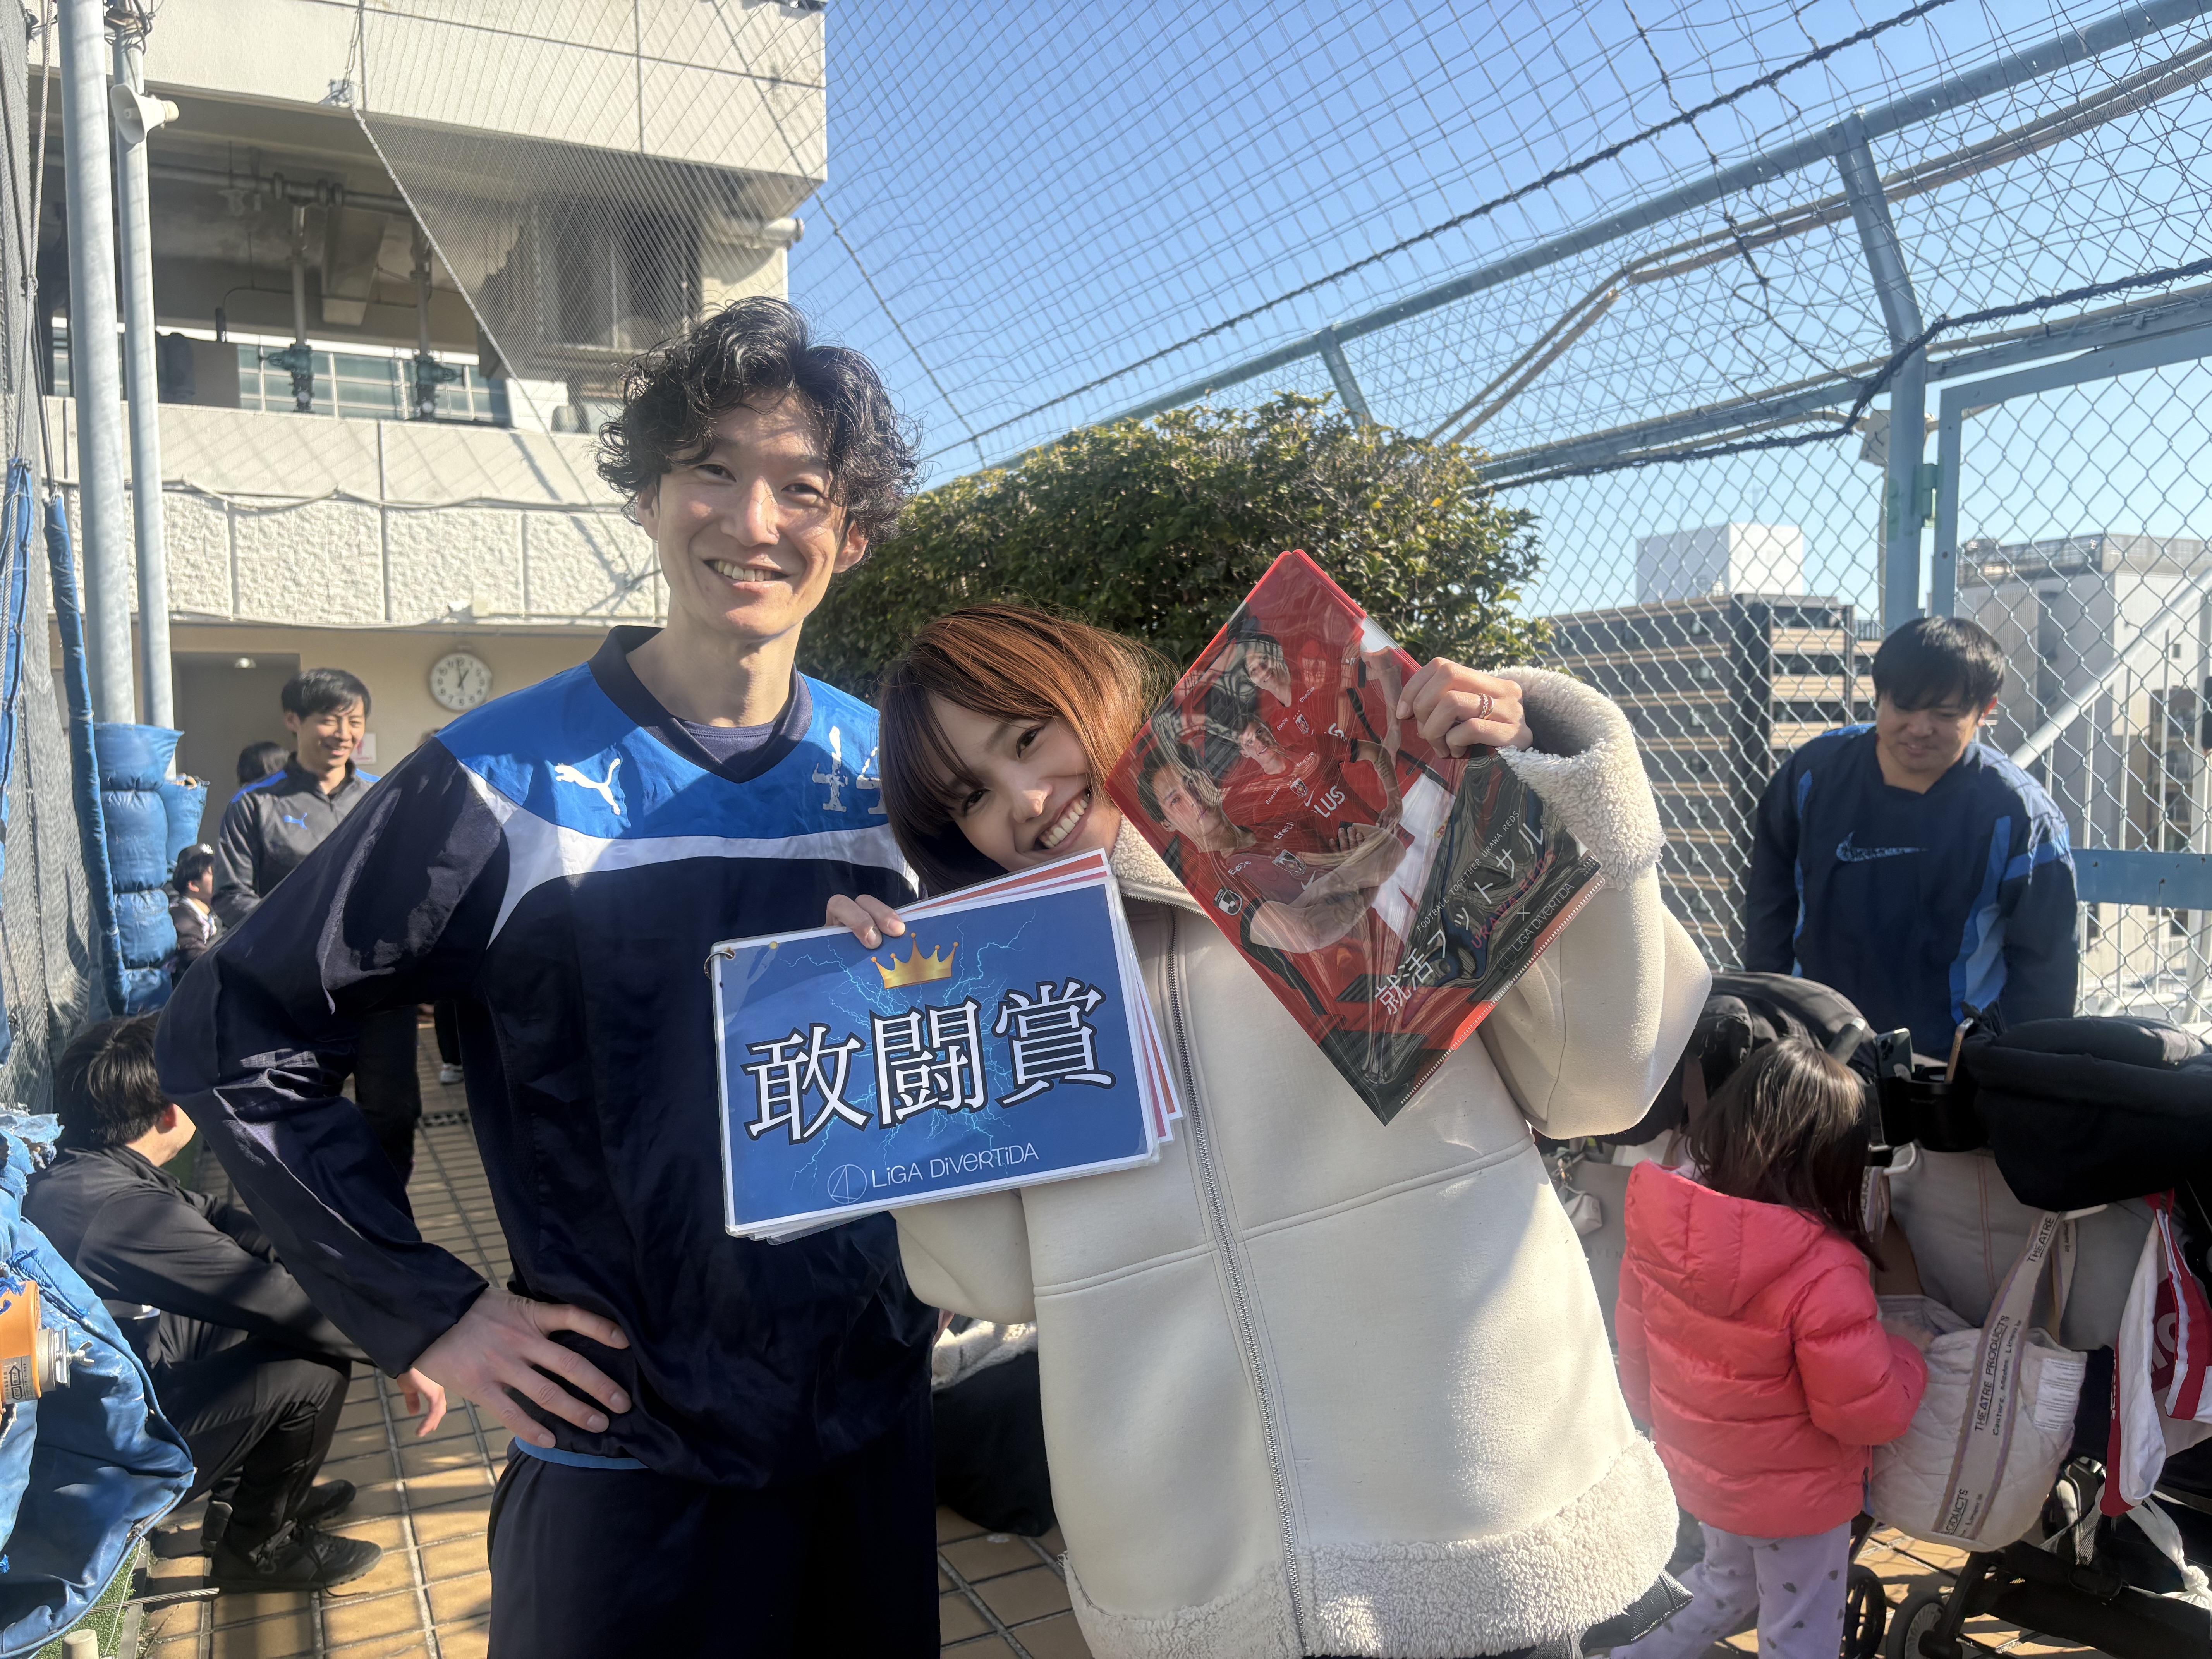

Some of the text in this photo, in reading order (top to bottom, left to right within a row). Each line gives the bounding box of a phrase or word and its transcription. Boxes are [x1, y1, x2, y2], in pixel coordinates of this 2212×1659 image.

[1375, 823, 1544, 1015] 就活フットサル
[1417, 811, 1520, 933] FOOTBALL TOGETHER URAWA REDS
[1470, 895, 1519, 949] URAWA
[741, 978, 1116, 1144] 敢闘賞
[2027, 1217, 2054, 1262] THEATRE
[1975, 1381, 1992, 1431] THEATRE
[1986, 1315, 2009, 1376] PRODUCTS
